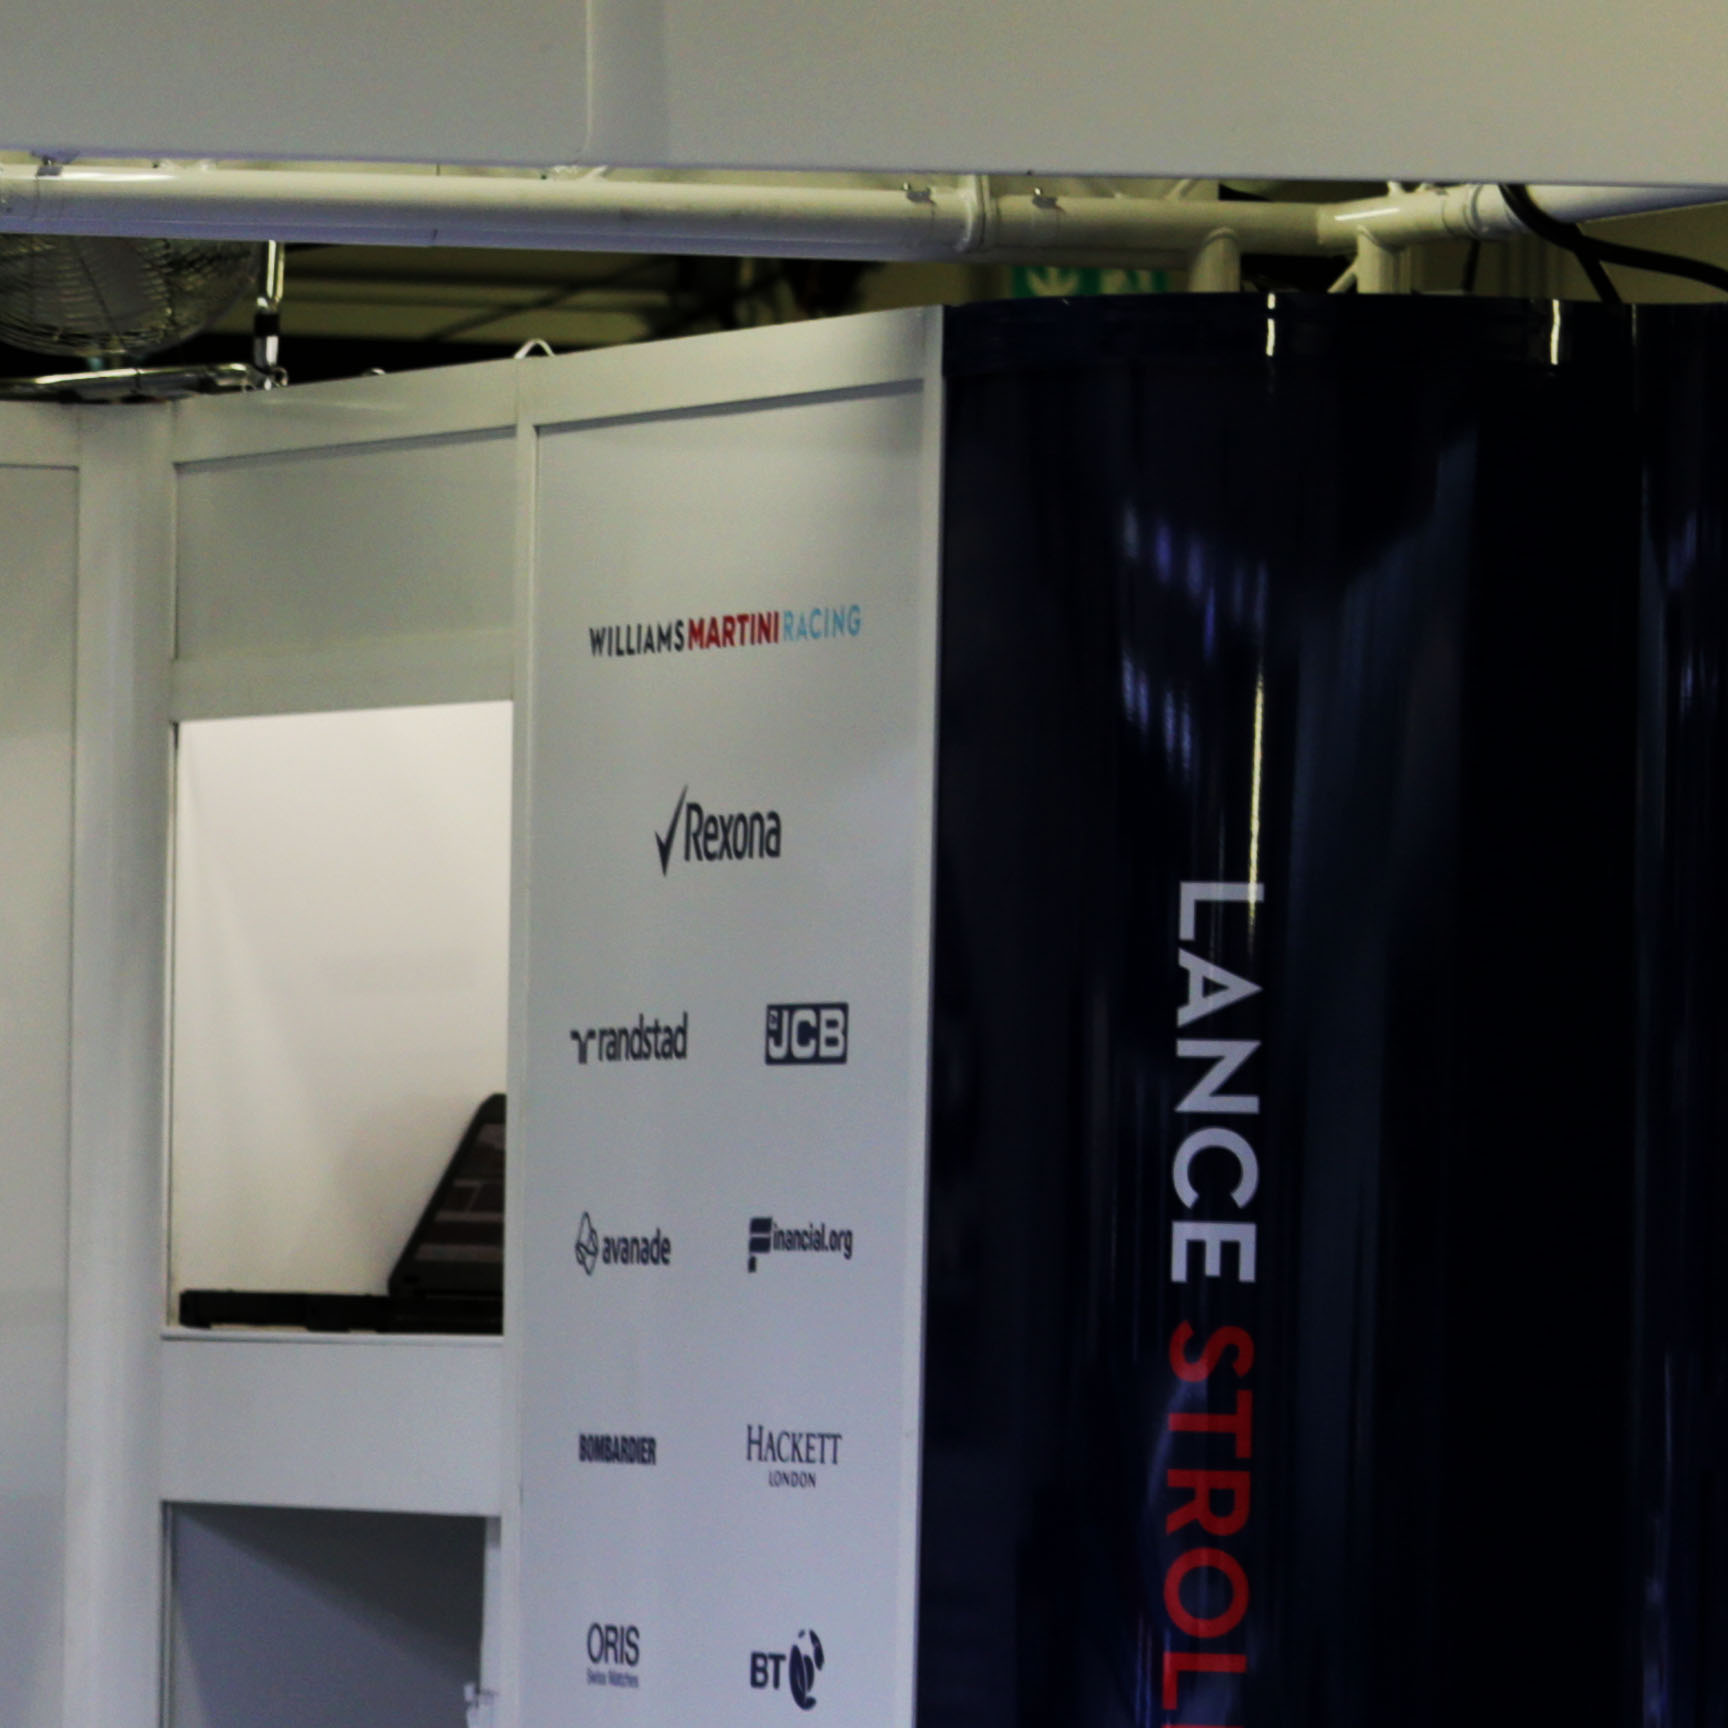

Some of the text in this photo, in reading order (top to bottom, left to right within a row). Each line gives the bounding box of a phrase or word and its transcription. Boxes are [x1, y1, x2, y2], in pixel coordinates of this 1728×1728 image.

[589, 604, 862, 658] WILLIAMS MARTINI RACING
[684, 802, 781, 862] Rexona
[597, 1012, 688, 1062] randstad
[768, 1008, 845, 1059] JCB
[1171, 881, 1264, 1283] LANCE
[602, 1228, 671, 1267] avanade
[578, 1433, 657, 1465] BOMBARDIER
[747, 1425, 842, 1466] HACKETT
[768, 1471, 817, 1488] LONDON
[587, 1622, 640, 1668] ORIS
[750, 1652, 786, 1689] BT
